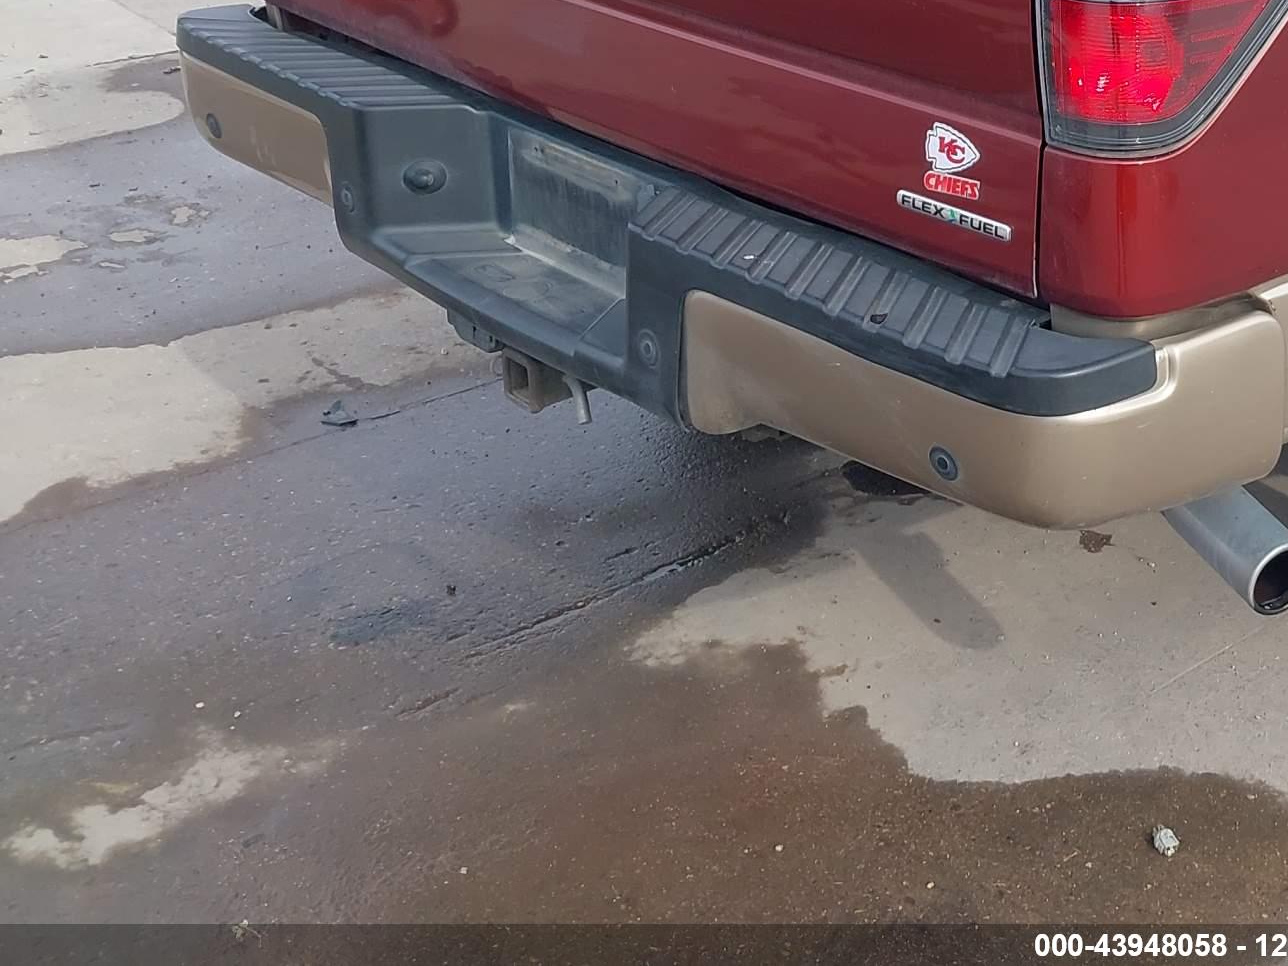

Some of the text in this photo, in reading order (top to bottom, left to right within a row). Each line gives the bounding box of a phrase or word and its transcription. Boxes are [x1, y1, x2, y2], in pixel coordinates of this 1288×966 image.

[938, 135, 966, 164] KC
[924, 172, 979, 199] CHIEFS
[901, 193, 1005, 240] FLEX FUEL
